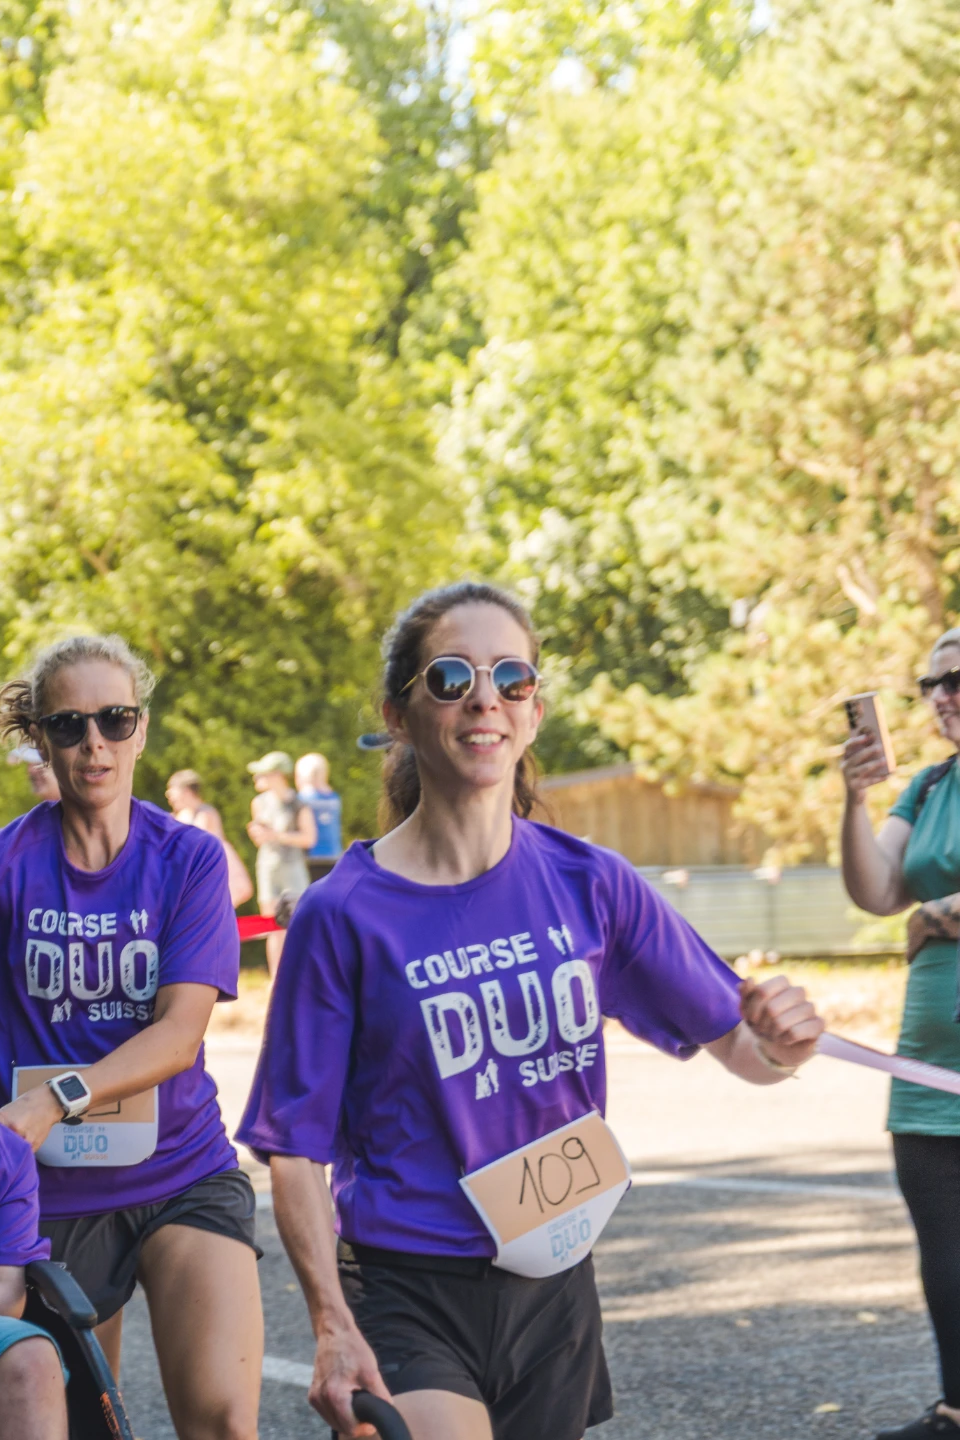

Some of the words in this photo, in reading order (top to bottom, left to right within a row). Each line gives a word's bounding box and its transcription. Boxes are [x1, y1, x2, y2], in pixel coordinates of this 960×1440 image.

[25, 938, 159, 1001] DUO
[404, 931, 539, 990] COURSE
[420, 958, 600, 1080] DUO
[64, 1134, 108, 1153] DUO
[519, 1137, 600, 1213] 109
[550, 1217, 591, 1259] DUO
